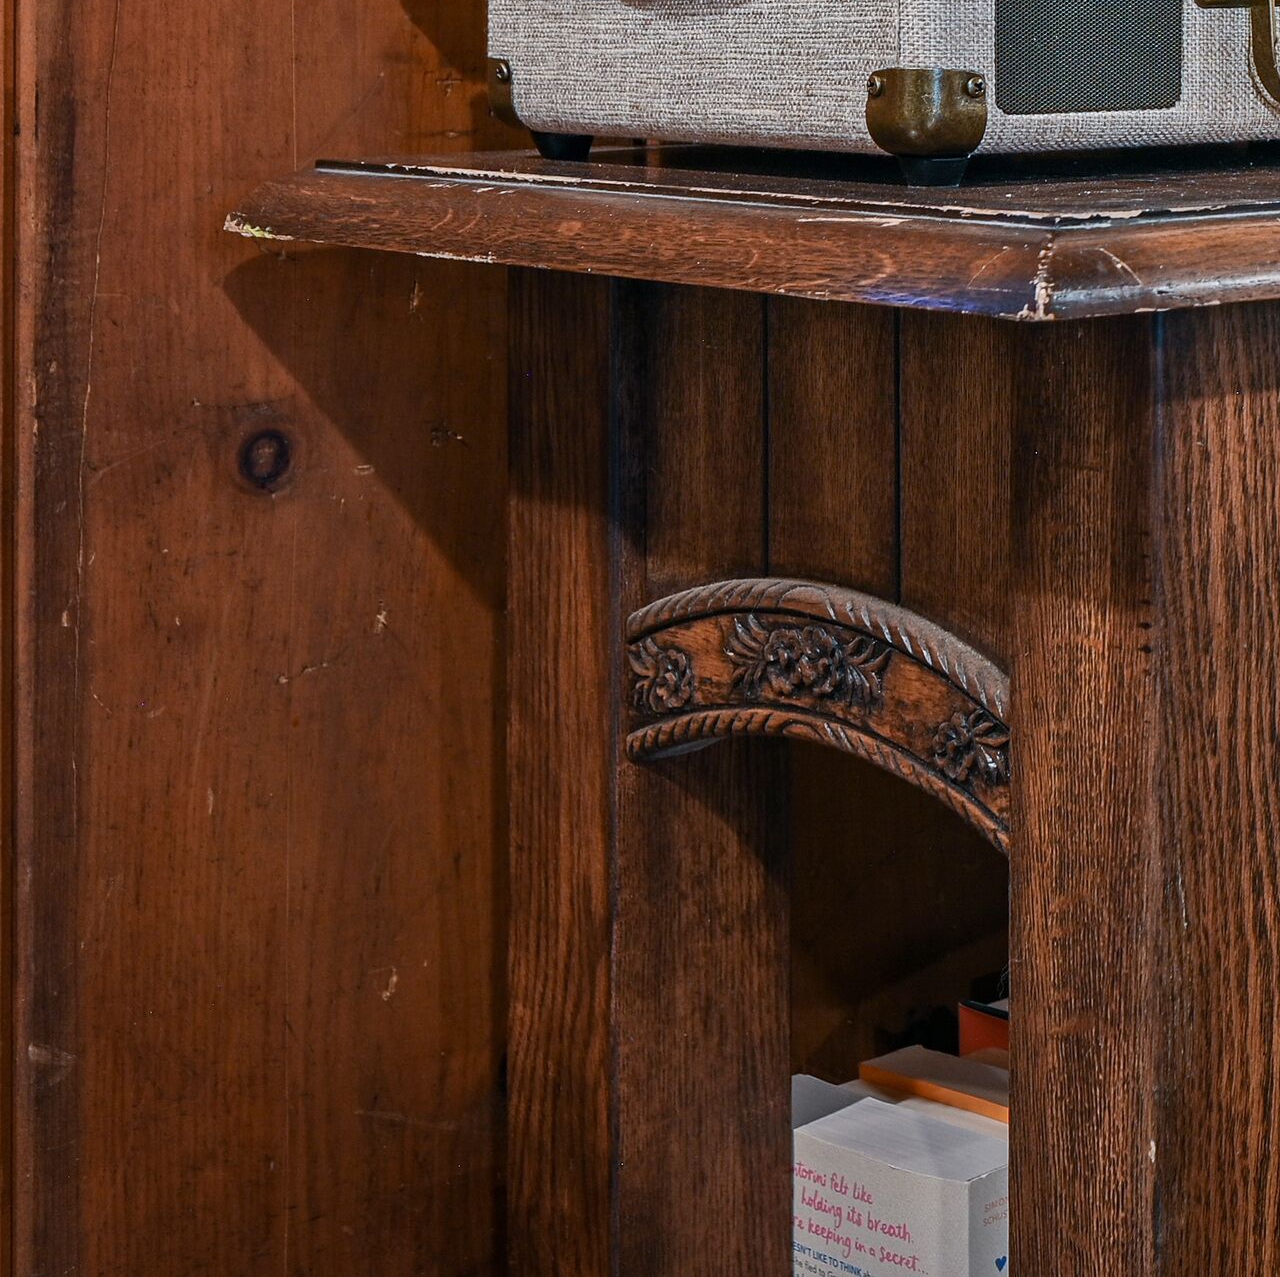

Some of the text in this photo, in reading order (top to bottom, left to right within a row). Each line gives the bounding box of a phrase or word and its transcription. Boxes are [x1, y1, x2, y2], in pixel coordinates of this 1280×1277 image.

[830, 1172, 849, 1196] felt
[853, 1183, 874, 1205] like
[801, 1186, 914, 1244] holding its breath.
[808, 1217, 852, 1260] keeping
[854, 1239, 867, 1254] in
[869, 1248, 875, 1257] a
[812, 1249, 828, 1265] LIKE
[828, 1255, 839, 1269] TO
[839, 1258, 862, 1276] THINK
